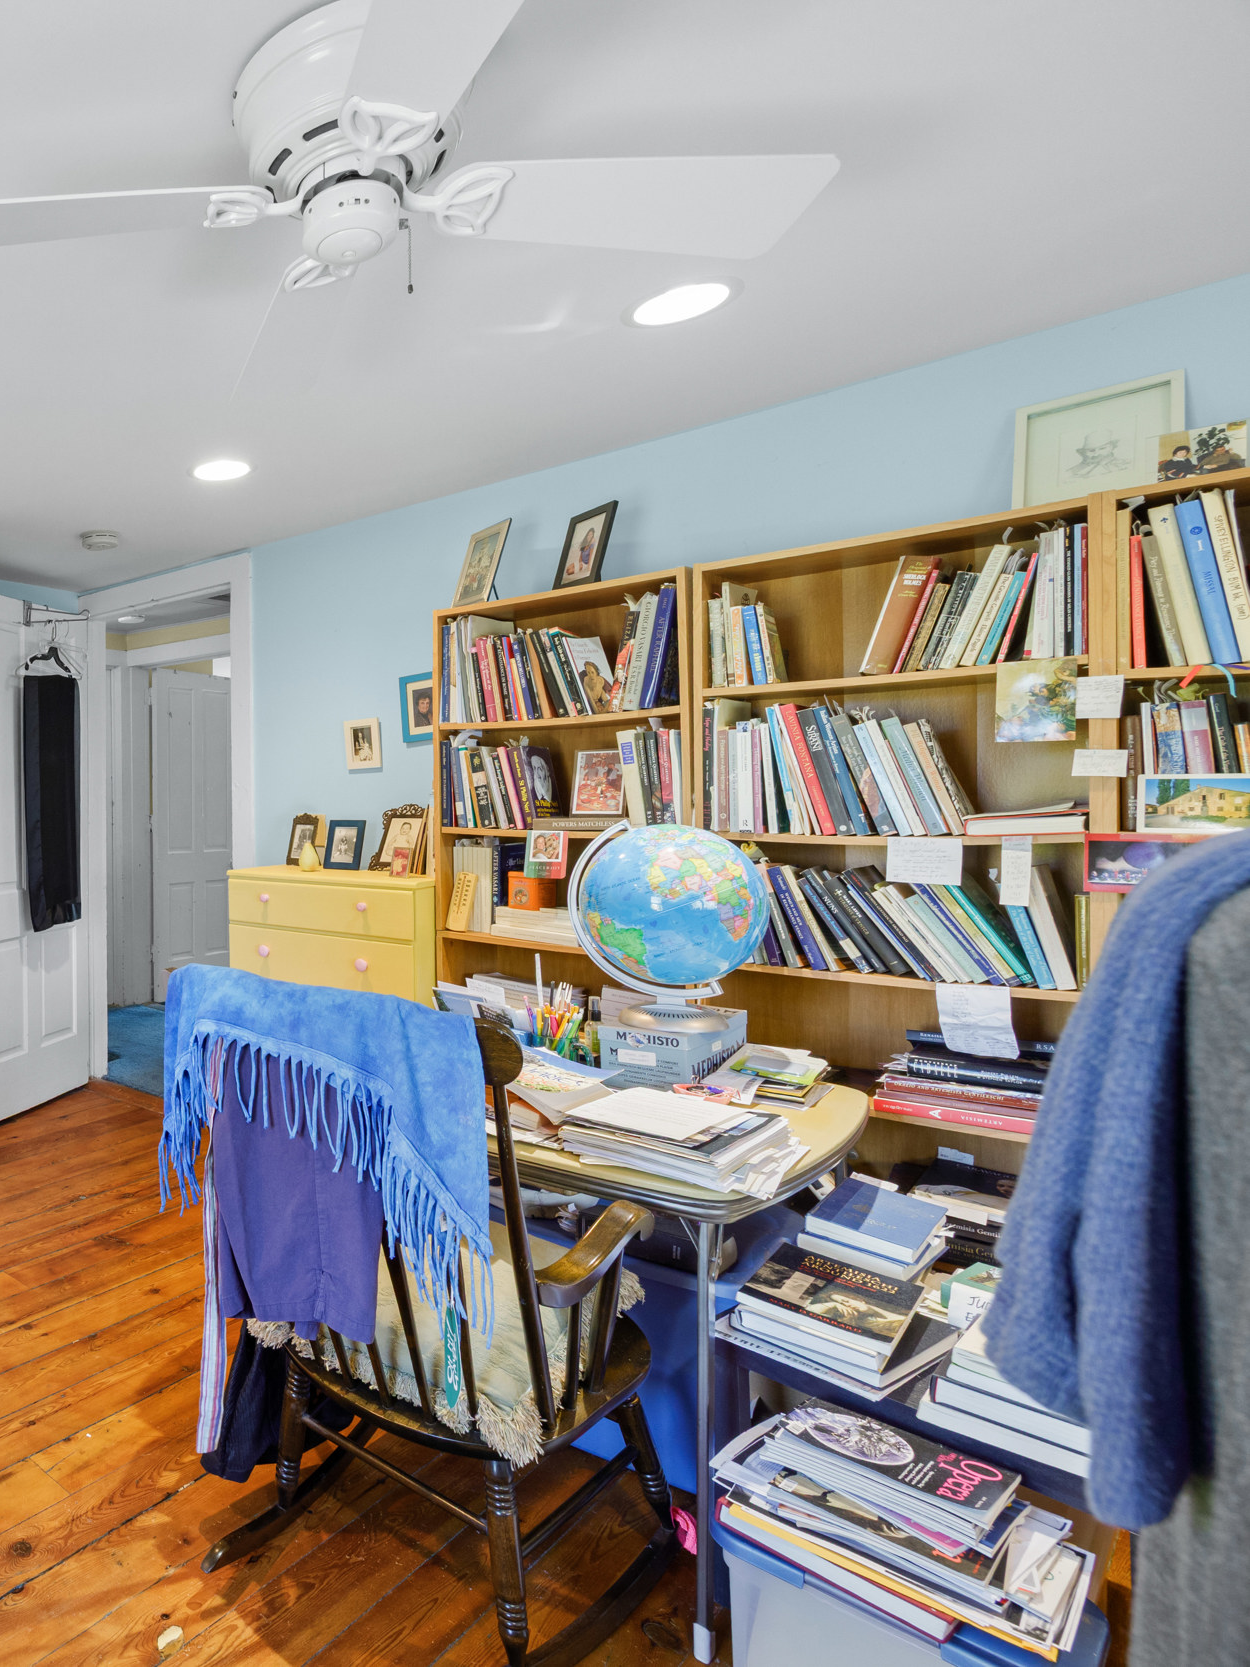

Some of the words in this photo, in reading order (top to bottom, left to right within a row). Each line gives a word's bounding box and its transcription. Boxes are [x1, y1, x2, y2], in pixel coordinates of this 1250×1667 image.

[639, 600, 653, 636] GIORGIO
[654, 615, 666, 640] AFTER
[633, 634, 646, 663] VASARI
[648, 639, 661, 673] RAPHAEL
[783, 709, 802, 742] LAVINIA
[795, 741, 815, 779] FONTANA
[805, 724, 823, 752] SIRANI
[551, 820, 577, 828] POWERS
[577, 820, 616, 828] MATCHLESS
[820, 894, 838, 916] NUNS
[616, 1030, 680, 1048] MHISTO
[808, 1312, 862, 1334] GARRARD
[935, 1460, 1003, 1501] Opera
